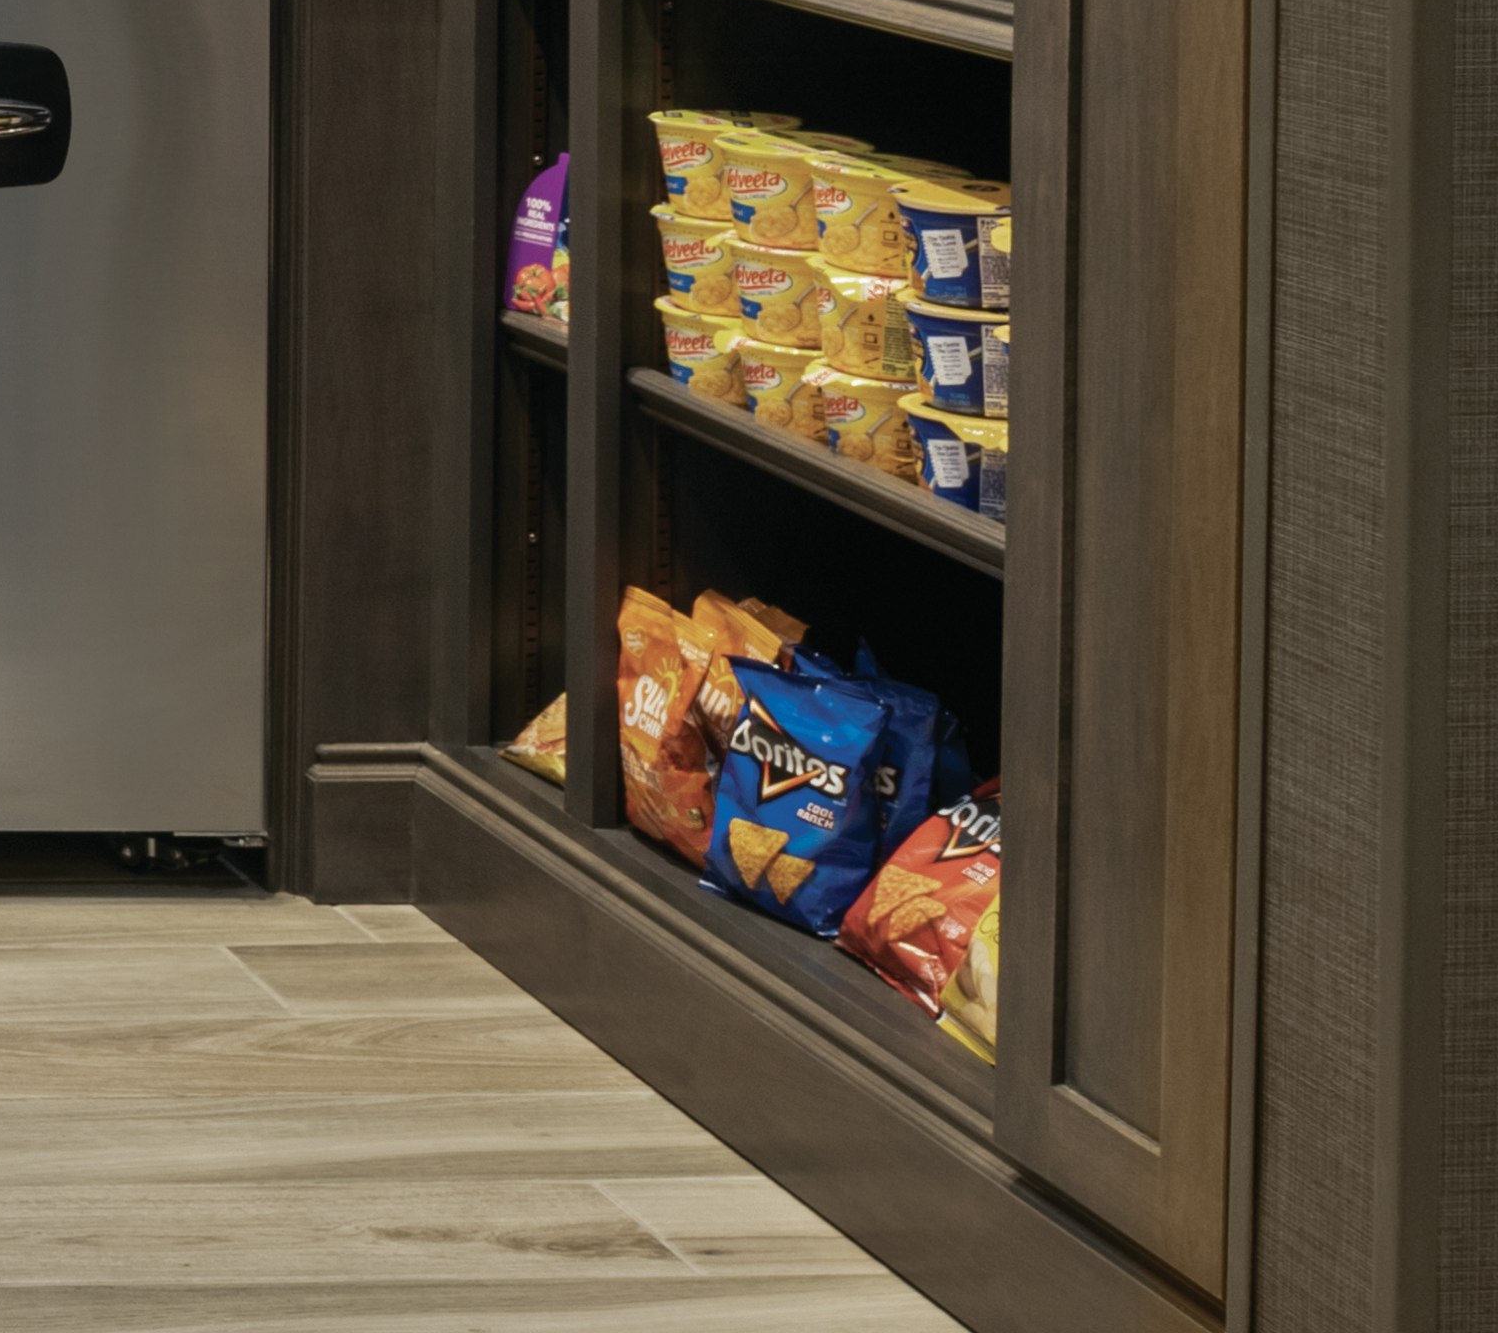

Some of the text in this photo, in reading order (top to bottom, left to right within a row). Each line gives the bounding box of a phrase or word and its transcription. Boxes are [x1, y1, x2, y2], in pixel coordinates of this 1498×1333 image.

[526, 197, 552, 213] 100%
[730, 718, 848, 796] Doritos
[796, 807, 835, 831] RANCH
[806, 801, 835, 820] COOL
